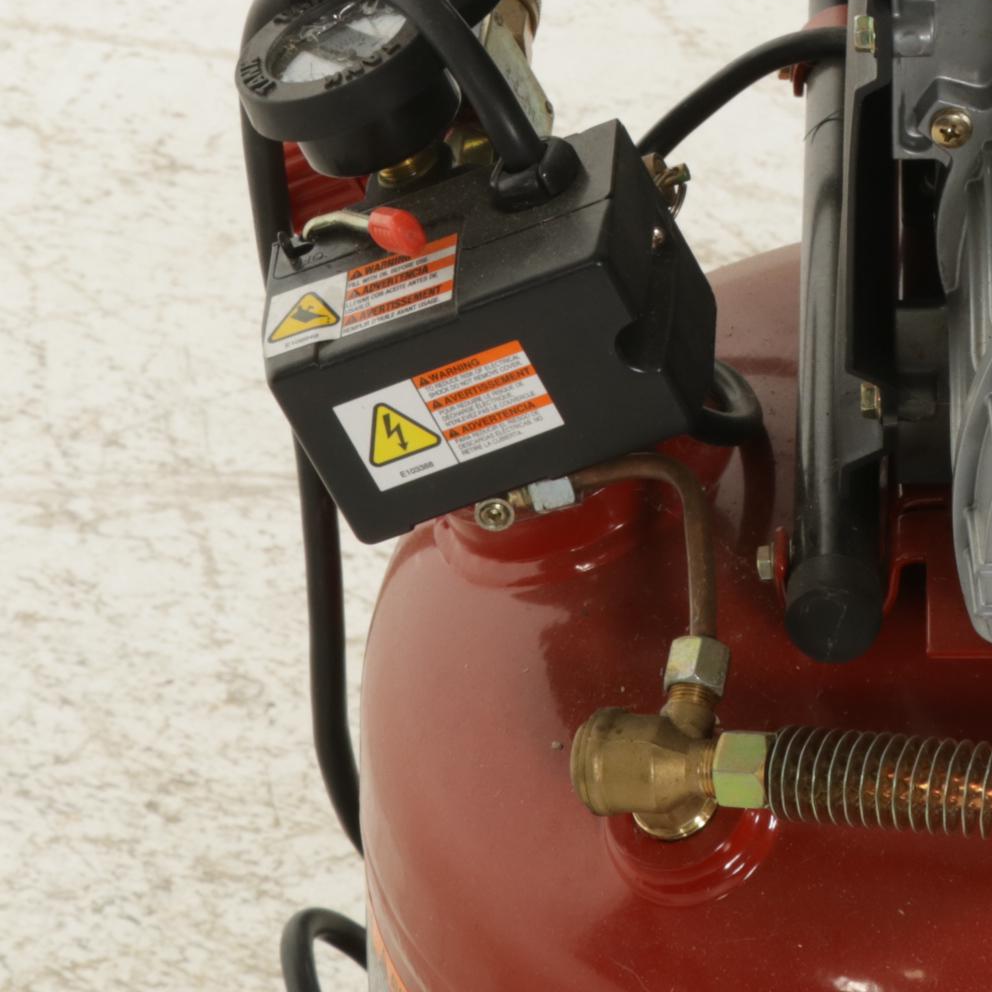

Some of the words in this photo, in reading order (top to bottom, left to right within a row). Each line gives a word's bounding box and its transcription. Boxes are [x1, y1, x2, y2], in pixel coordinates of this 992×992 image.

[364, 265, 429, 294] ADVERTENCIA
[430, 358, 480, 381] WARNING
[443, 366, 531, 405] AVERTISSEMENT
[461, 400, 536, 433] ADVERTENCIA
